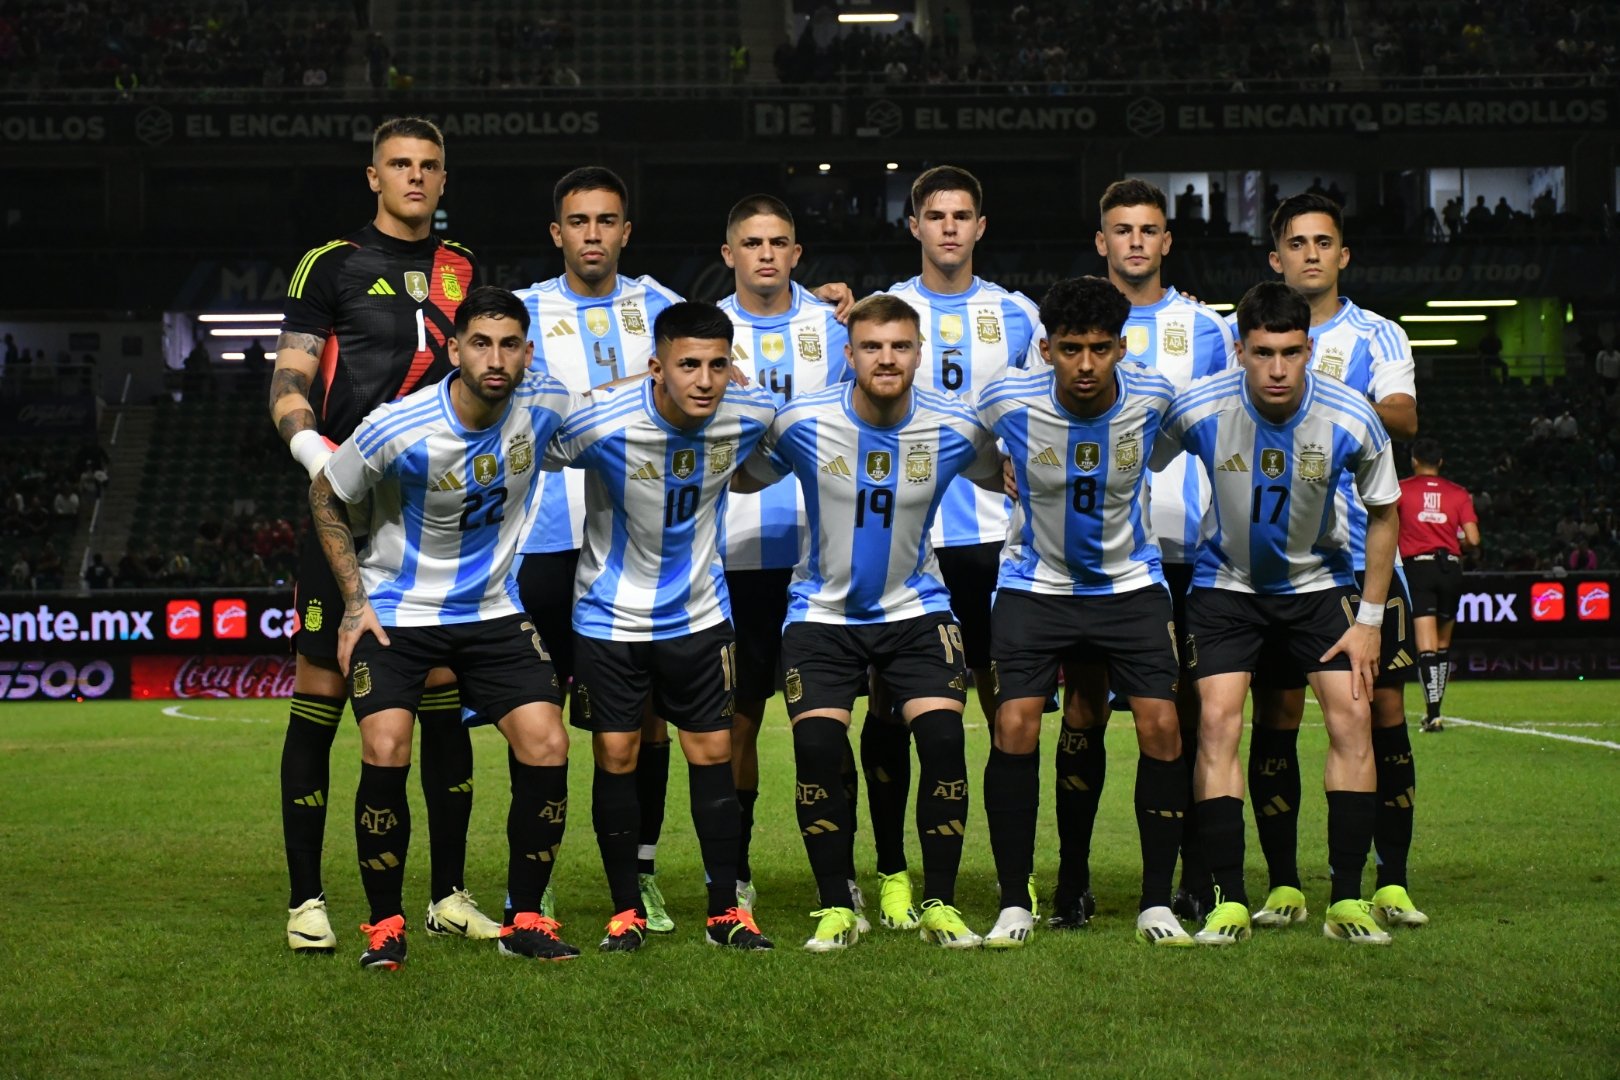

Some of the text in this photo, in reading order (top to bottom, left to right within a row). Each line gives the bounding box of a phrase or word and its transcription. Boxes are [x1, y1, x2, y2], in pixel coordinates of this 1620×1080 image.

[0, 115, 105, 140] OLLOS
[186, 114, 221, 138] EL
[229, 113, 373, 138] ENCANTO
[914, 106, 1097, 130] EL ENCANTO
[1178, 99, 1608, 128] EL ENCANTO DESARROLLOS
[1471, 263, 1542, 282] TODO
[416, 308, 426, 352] 1
[593, 341, 618, 380] 4
[942, 348, 963, 390] 6
[459, 486, 508, 532] 22
[665, 485, 699, 528] 10
[856, 488, 893, 529] 19
[1073, 477, 1096, 514] 8
[1252, 486, 1289, 525] 17
[360, 804, 398, 836] AFA
[536, 796, 567, 824] AF
